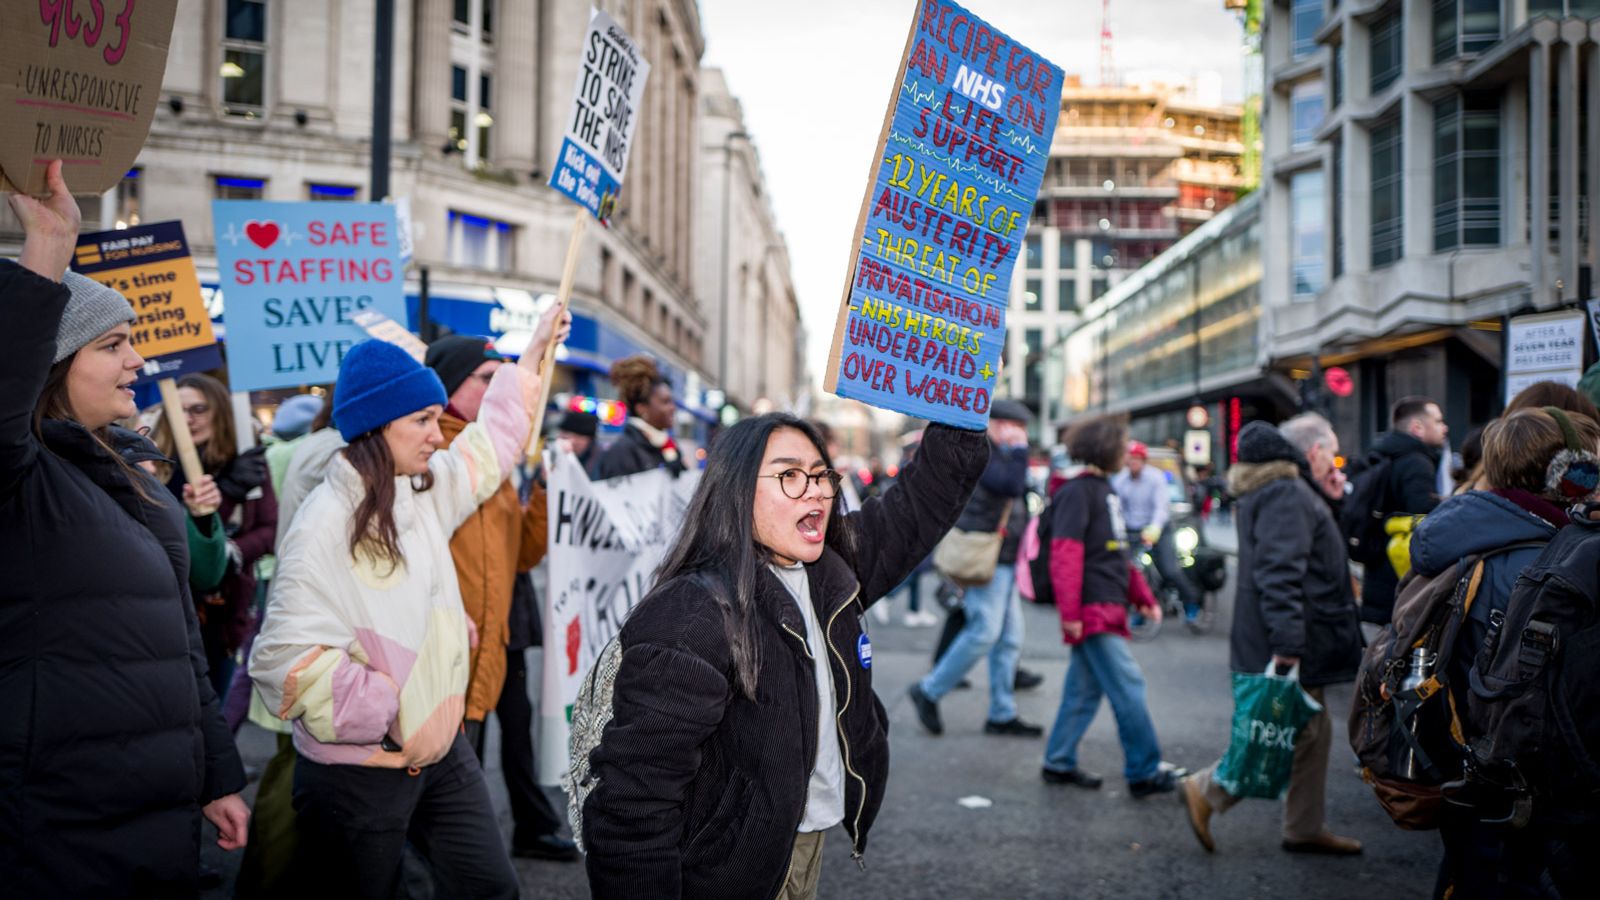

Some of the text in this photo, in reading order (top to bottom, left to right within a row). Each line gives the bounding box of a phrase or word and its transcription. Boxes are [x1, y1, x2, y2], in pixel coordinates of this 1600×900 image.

[587, 30, 635, 100] STRIKE
[922, 0, 1053, 103] RECIPE FOR
[581, 63, 632, 139] TO SAVE
[909, 38, 1046, 136] AN NHS ON
[34, 122, 104, 157] TO NURSES
[573, 99, 626, 173] THE NHS
[941, 91, 1004, 144] LIFE
[558, 167, 577, 192] the
[564, 144, 587, 174] Kick
[917, 164, 990, 226] YEARS
[989, 206, 1022, 236] OF
[101, 235, 154, 252] FAIR PAY
[307, 220, 388, 246] SAFE
[873, 187, 1012, 269] AUSTERITY
[132, 271, 177, 288] time
[234, 258, 393, 285] STAFFING
[857, 257, 1000, 330] PRIVATISATION
[962, 266, 997, 298] OF
[139, 290, 173, 309] pay
[153, 321, 202, 341] fairly
[849, 317, 977, 380] UNDERPAID
[903, 310, 986, 356] HEROES
[844, 351, 990, 415] OVER WORKED
[1250, 719, 1297, 752] next
